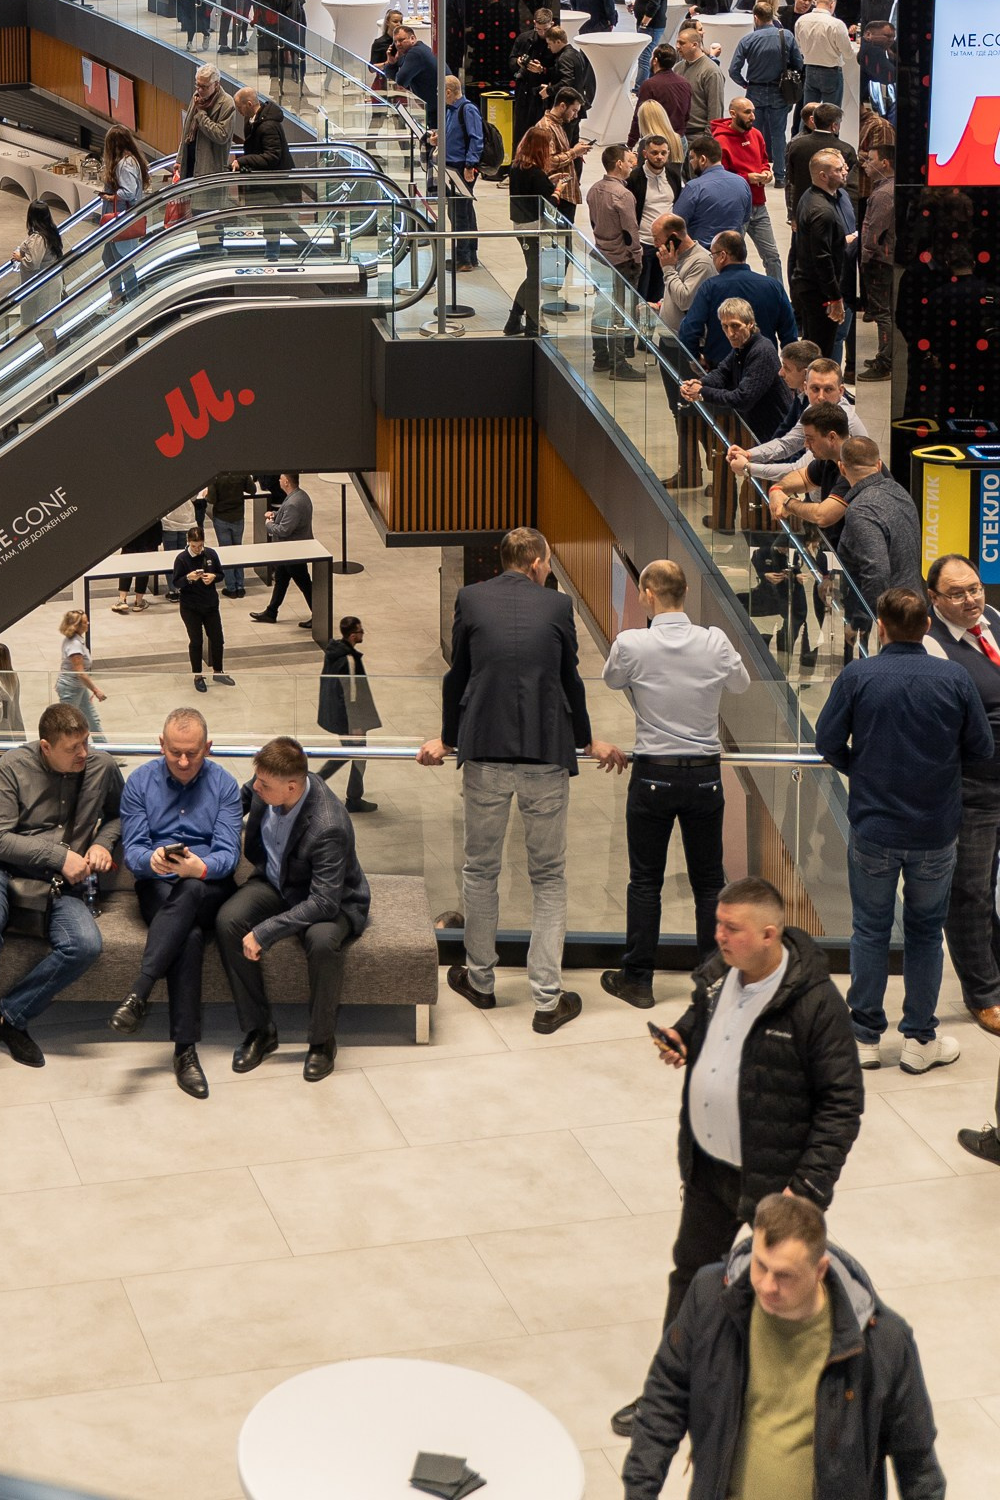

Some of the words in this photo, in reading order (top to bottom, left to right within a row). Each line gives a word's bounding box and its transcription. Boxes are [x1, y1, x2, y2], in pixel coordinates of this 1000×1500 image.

[0, 548, 19, 562] ТАМ,
[17, 538, 31, 551] ГДЕ
[29, 516, 61, 543] ДОЛЖЕН
[59, 505, 78, 520] БЫТЬ
[926, 476, 940, 561] ПЛАСТИК
[982, 474, 1000, 562] СТЕКЛО
